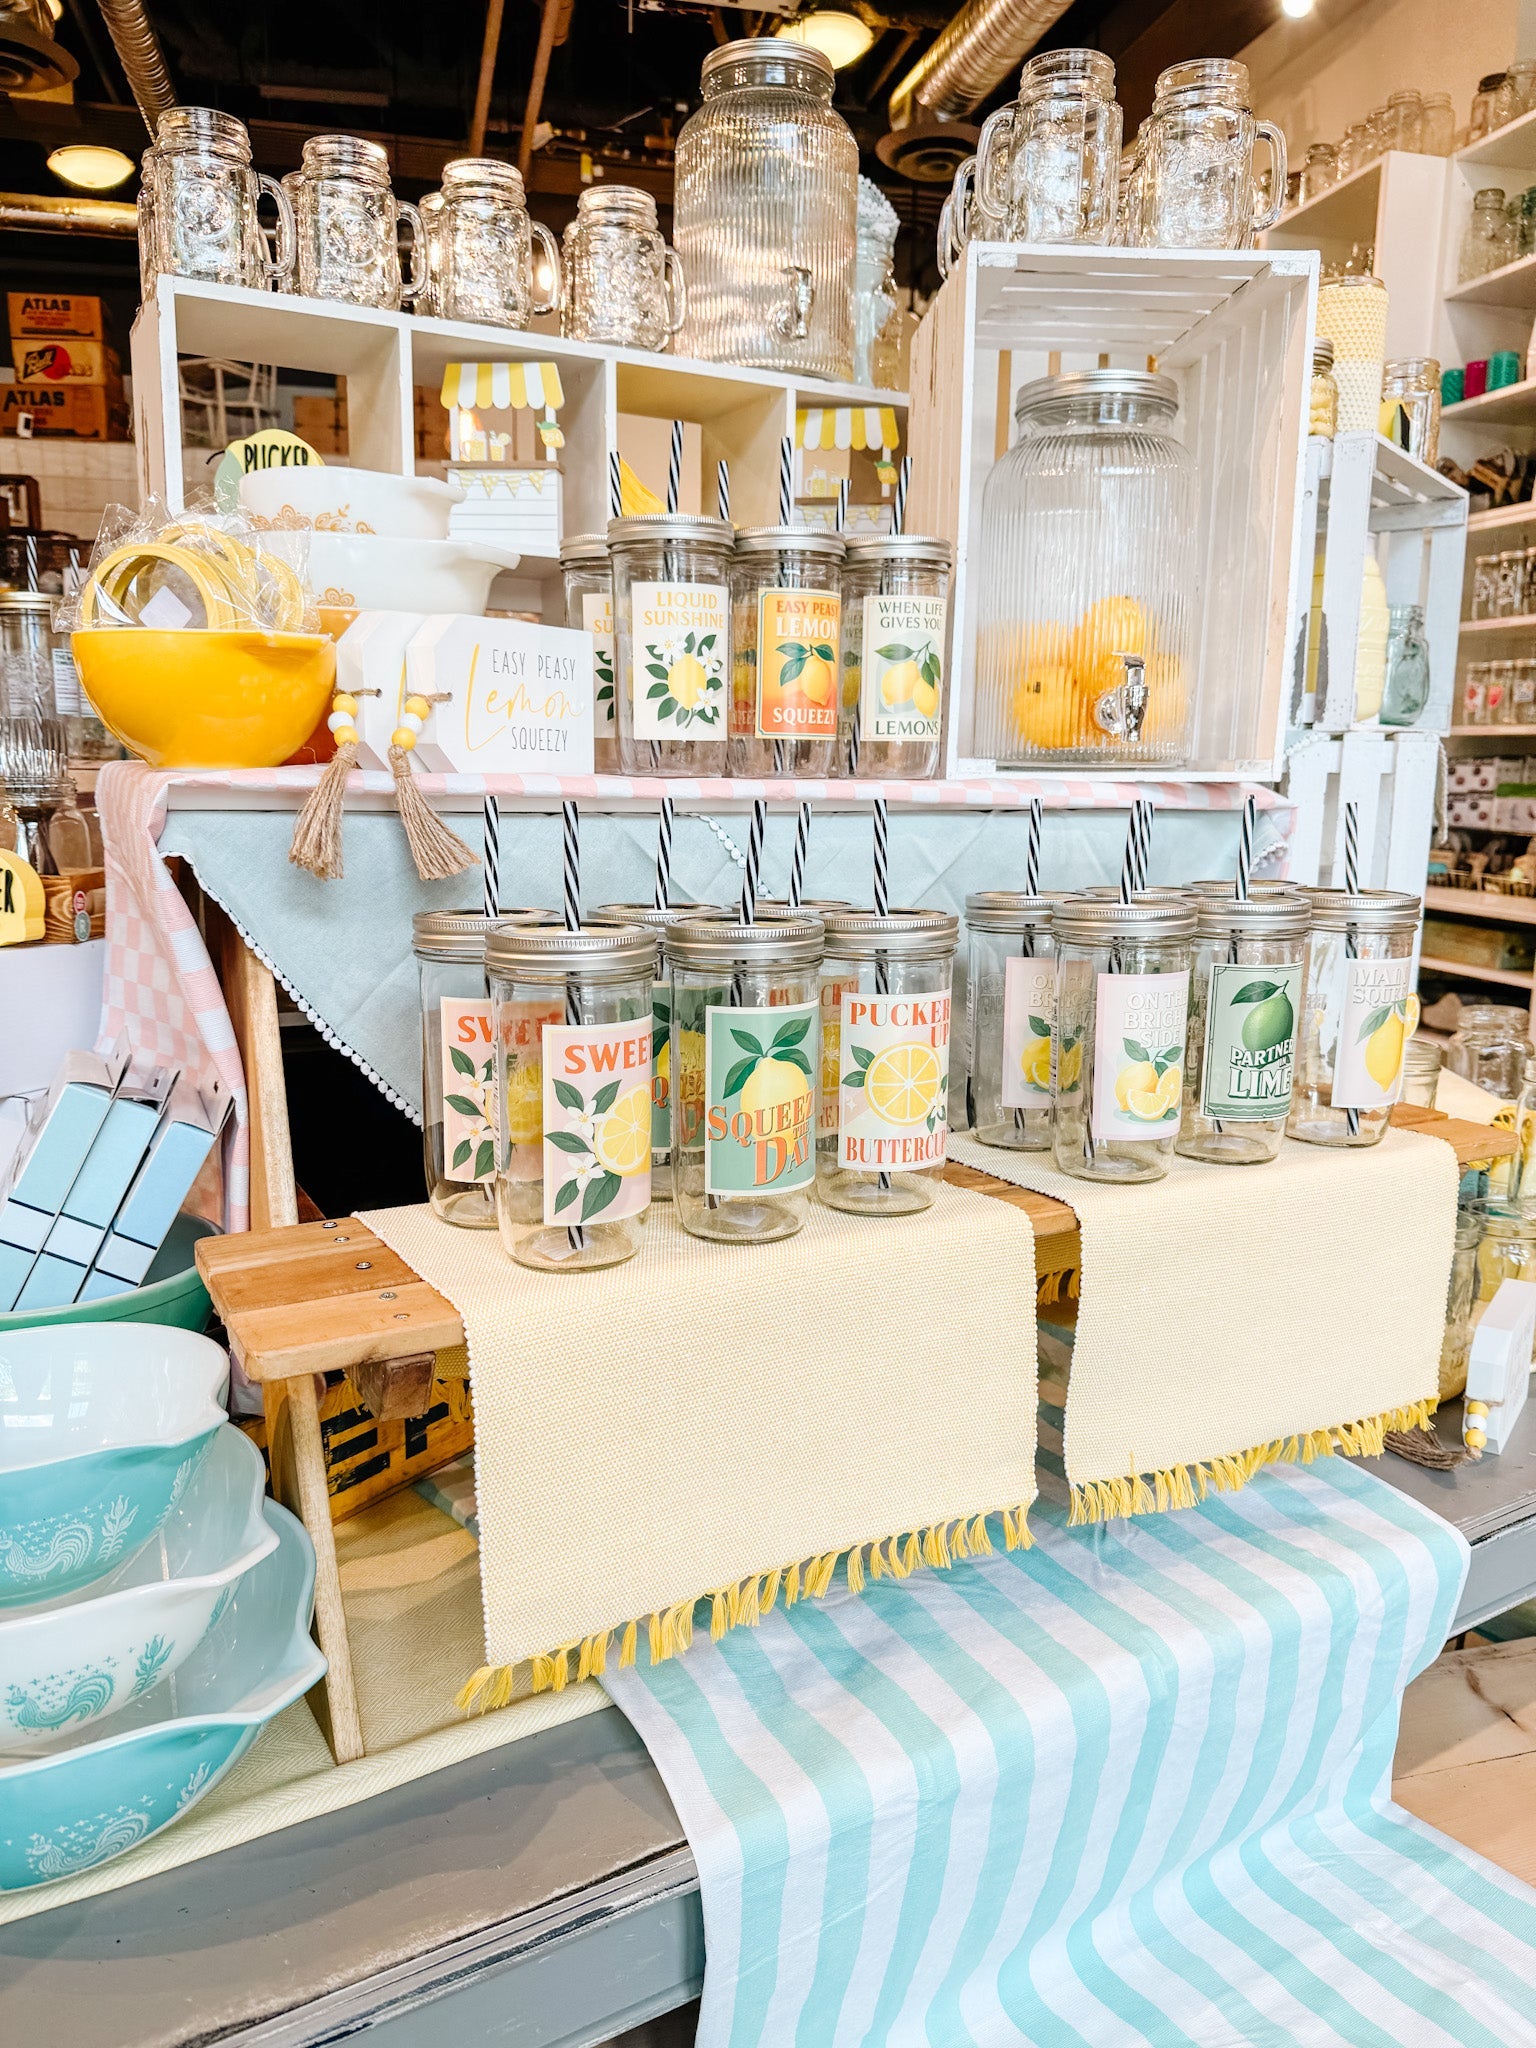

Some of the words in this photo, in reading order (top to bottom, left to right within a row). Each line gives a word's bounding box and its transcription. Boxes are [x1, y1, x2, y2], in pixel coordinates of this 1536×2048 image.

[21, 298, 71, 315] ATLAS
[3, 390, 65, 412] ATLAS
[657, 591, 718, 609] LIQUID
[776, 600, 808, 614] EASY
[878, 601, 921, 615] WHEN
[925, 602, 943, 617] LIFE
[643, 611, 724, 629] SUNSHINE
[776, 617, 838, 639] LEMON
[880, 616, 920, 629] GIVES
[492, 648, 526, 676] EASY
[538, 654, 576, 681] PEASY
[465, 643, 586, 752] Lemon
[511, 726, 568, 752] SQUEEZY
[876, 720, 939, 736] LEMONS
[1127, 991, 1160, 1011] ON
[849, 998, 950, 1027] PUCKER
[930, 1022, 949, 1049] UP
[1140, 1027, 1181, 1049] SIDE
[1228, 1066, 1292, 1099] LIME
[708, 1087, 814, 1147] SQUEEZ
[792, 1121, 810, 1140] THE
[845, 1130, 947, 1164] BUTTERCUP
[752, 1132, 812, 1186] DAY
